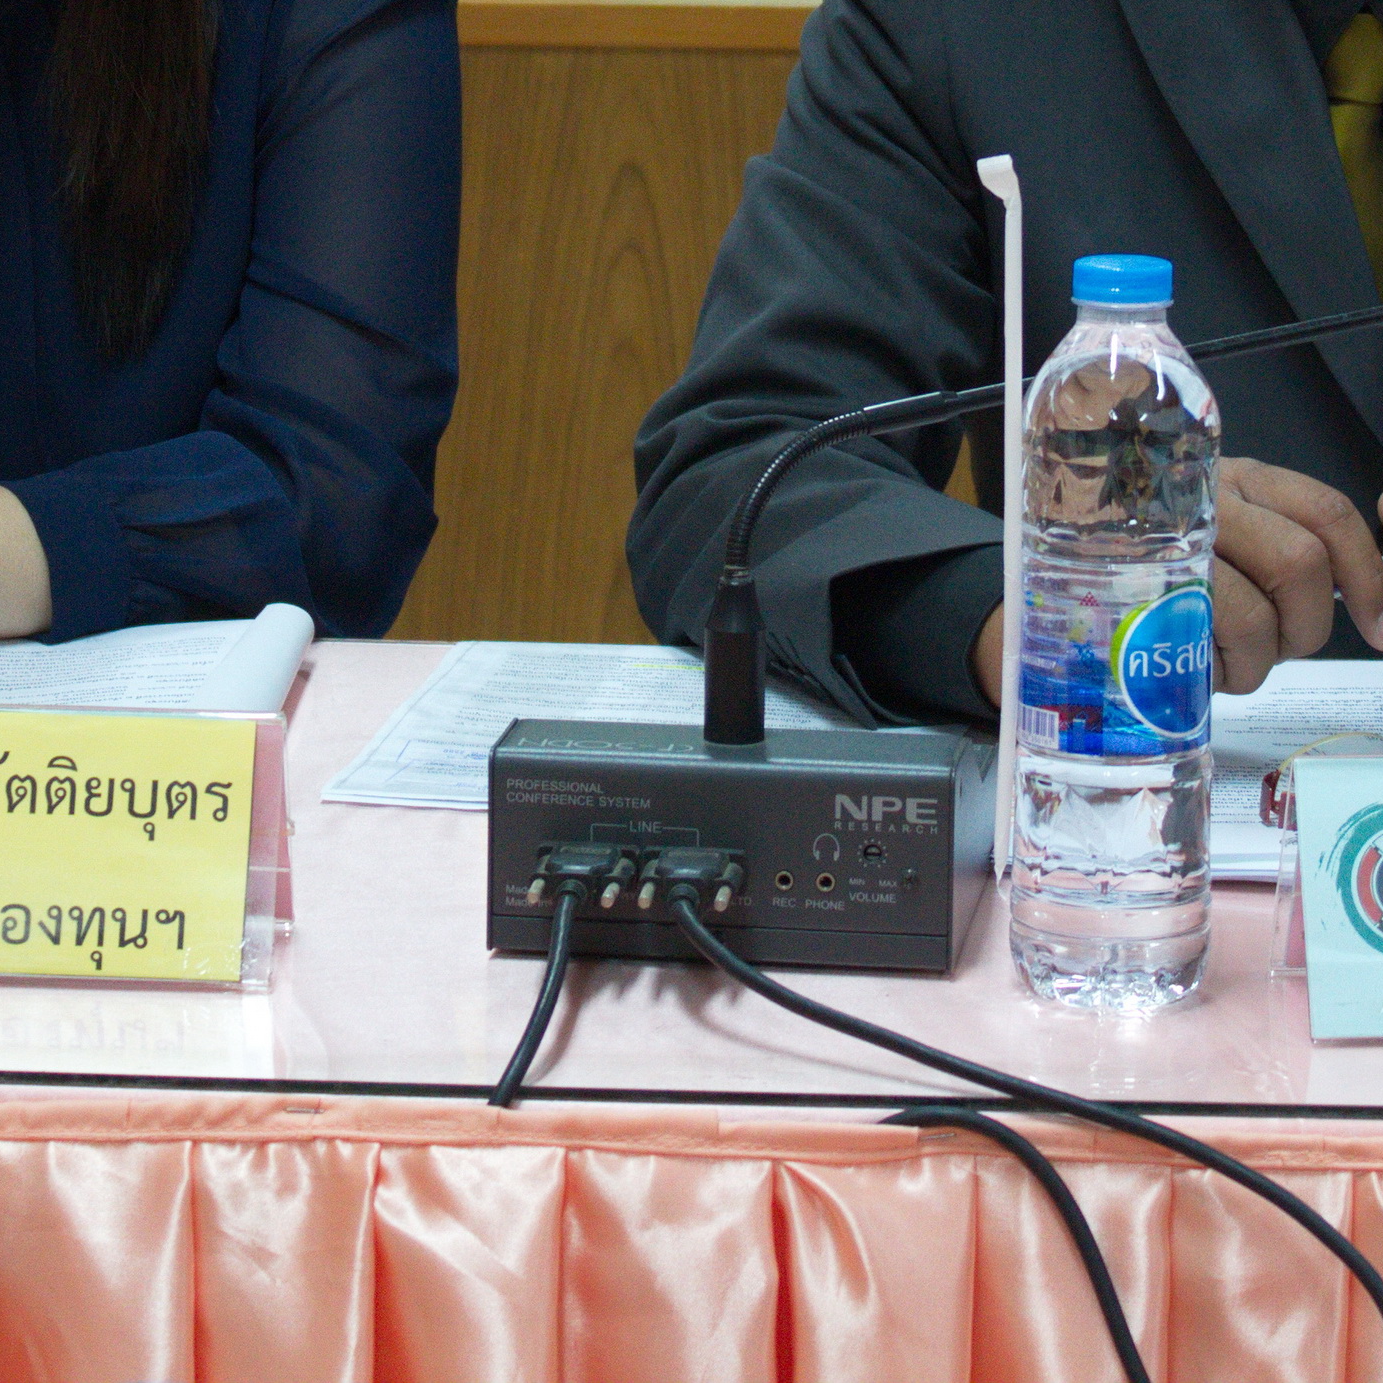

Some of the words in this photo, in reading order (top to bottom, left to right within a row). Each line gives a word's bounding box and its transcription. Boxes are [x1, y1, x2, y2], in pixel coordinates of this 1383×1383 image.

[506, 778, 604, 794] PROFESSIONAL
[506, 792, 594, 807] CONFERENCE
[598, 796, 651, 809] SYSTEM
[834, 794, 938, 824] NPE
[628, 820, 663, 834] LINE
[834, 821, 939, 835] RESEARCH
[772, 897, 796, 908] REC
[849, 891, 897, 904] VOLUME
[805, 899, 845, 911] PHONE
